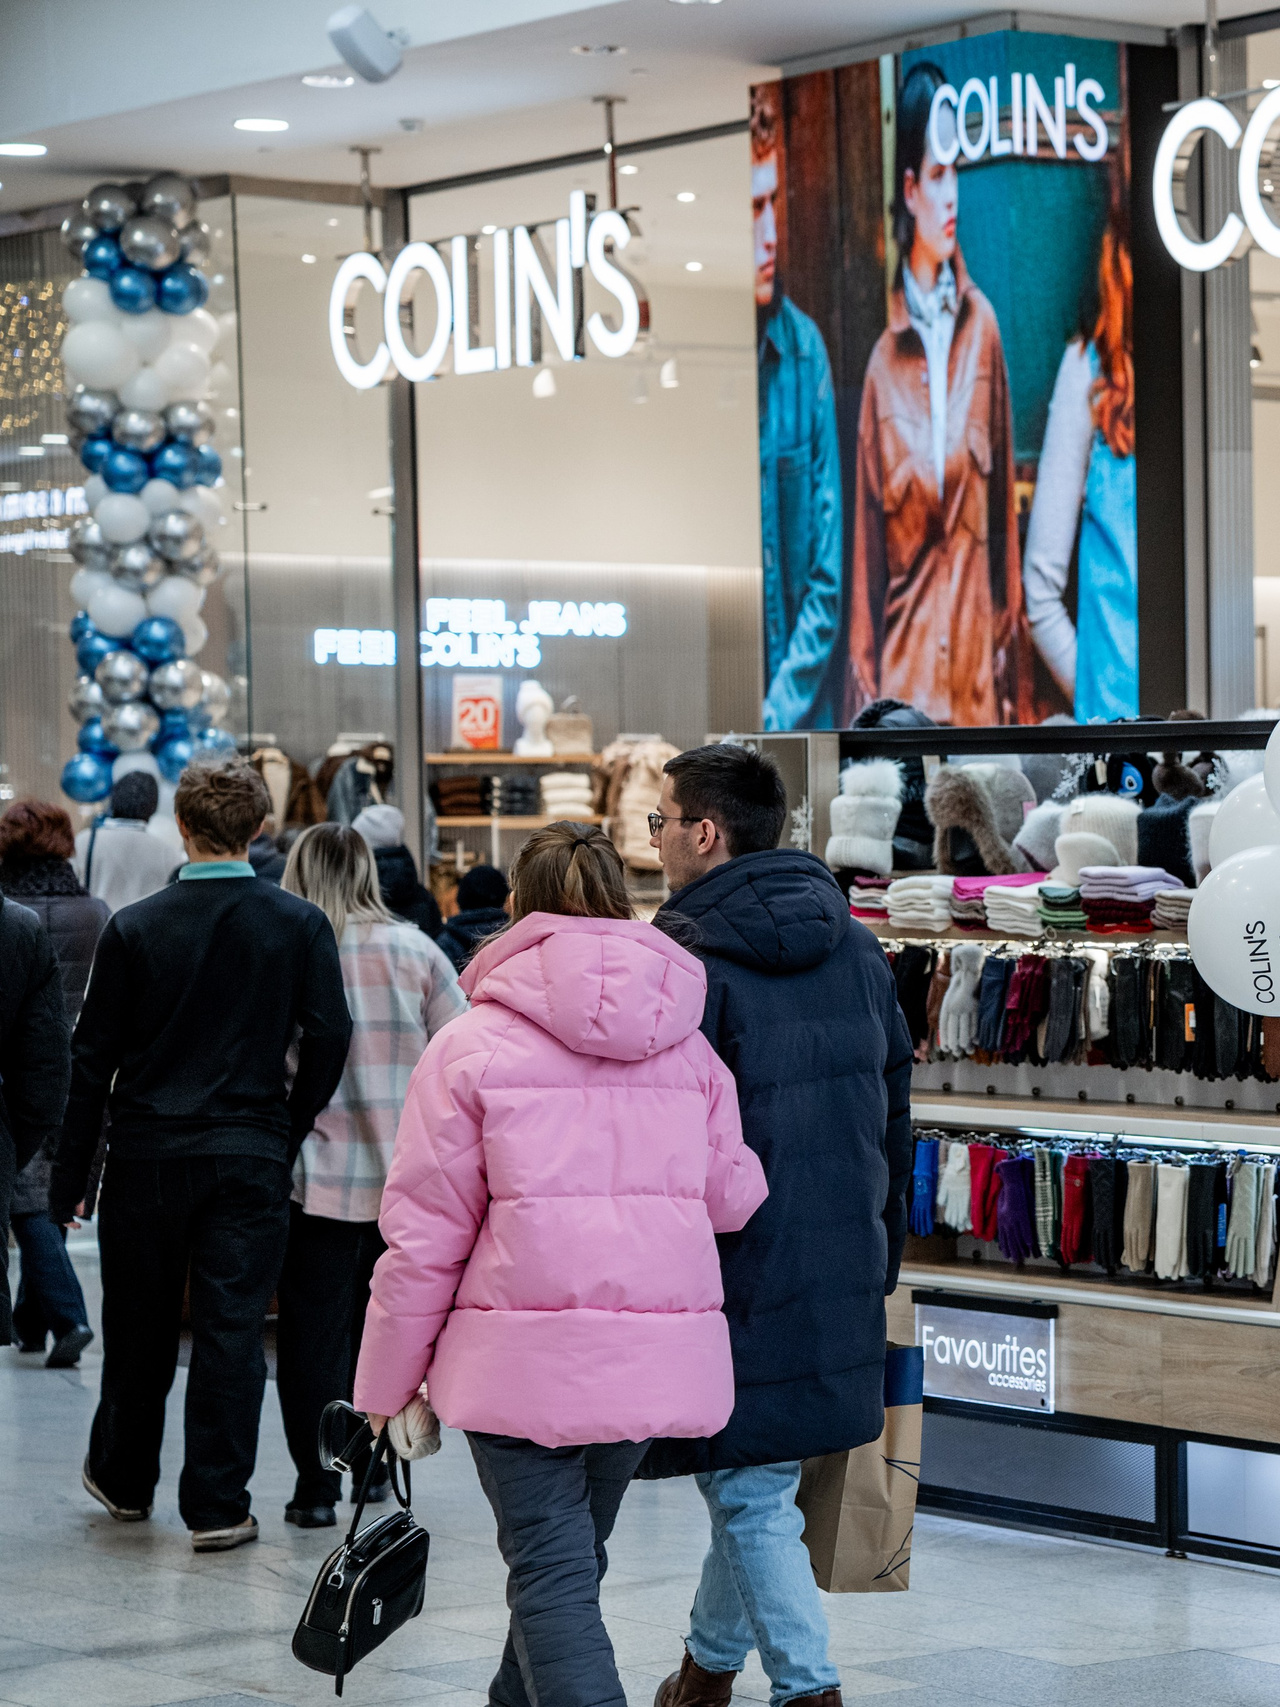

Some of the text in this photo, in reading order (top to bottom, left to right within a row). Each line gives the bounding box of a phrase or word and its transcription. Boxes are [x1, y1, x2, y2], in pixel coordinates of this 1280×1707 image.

[928, 62, 1108, 165] COLIN'S
[329, 189, 641, 390] COLIN'S
[426, 597, 628, 638] FEEL JEANS
[458, 700, 495, 731] 20
[1242, 920, 1276, 1004] COLIN'S
[922, 1325, 1047, 1378] Favourites
[987, 1372, 1047, 1394] accessories
